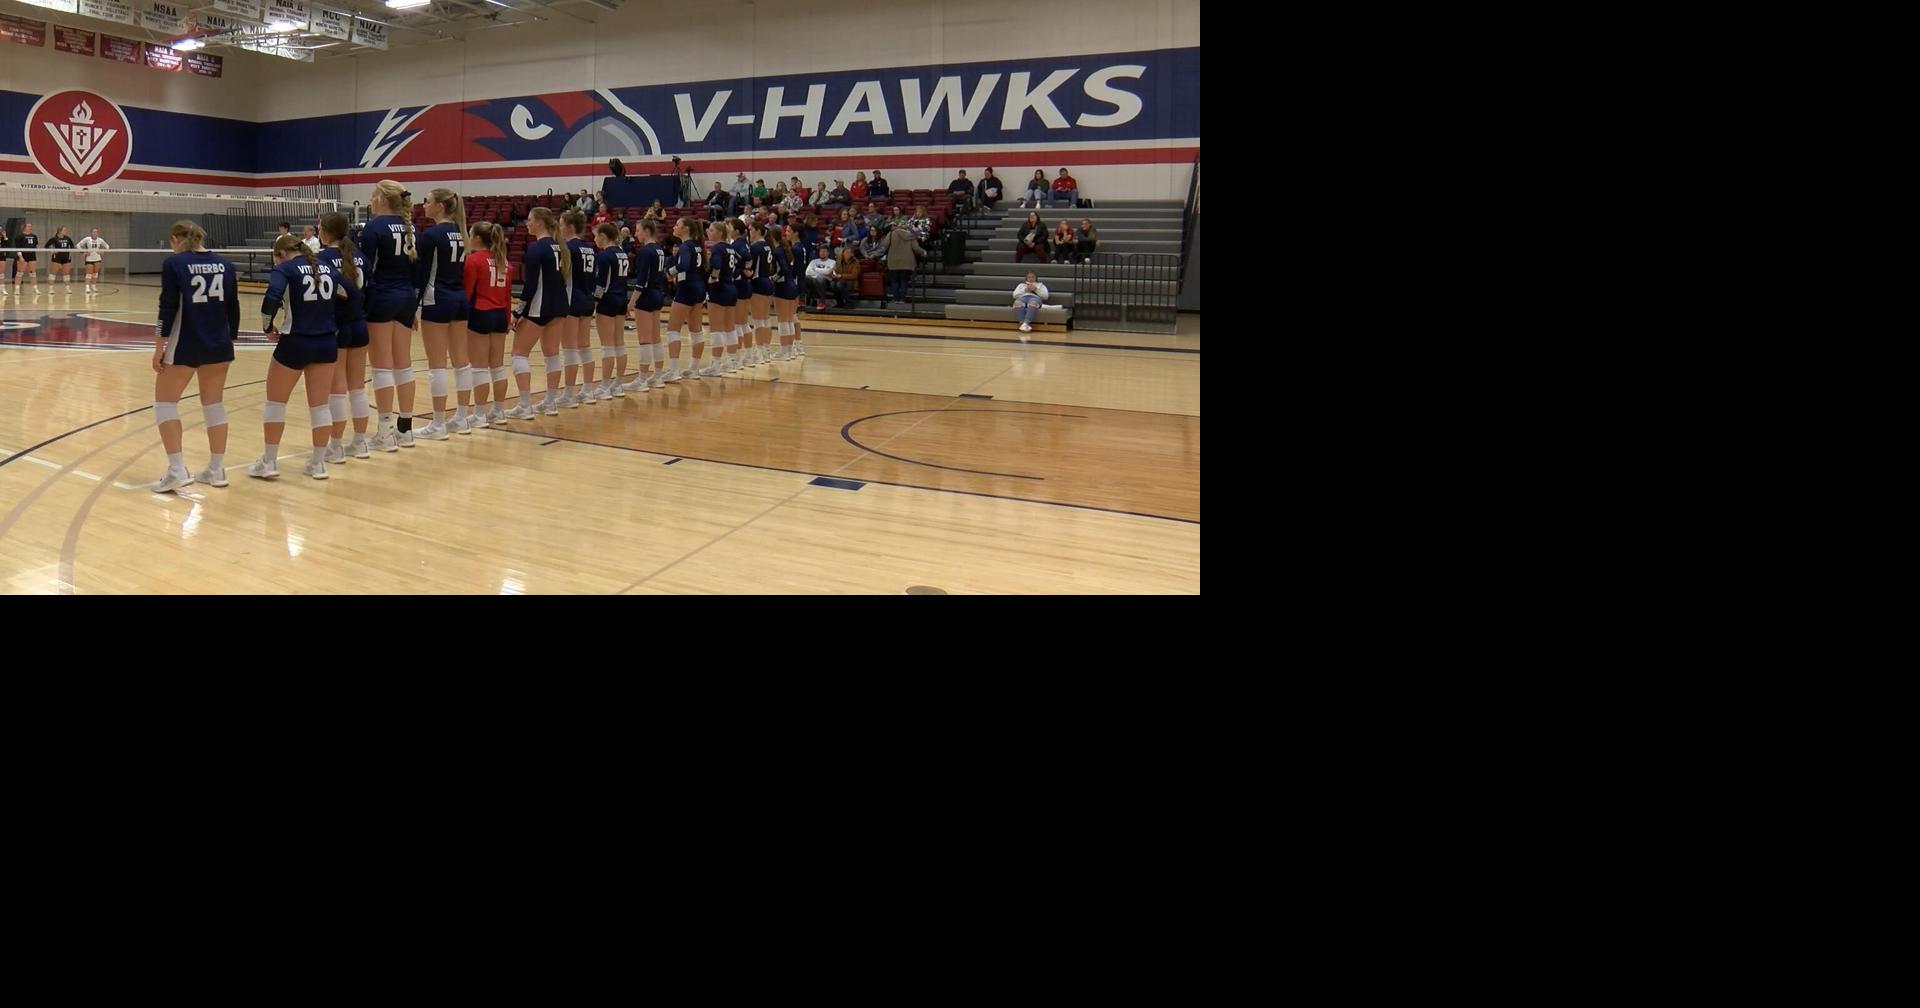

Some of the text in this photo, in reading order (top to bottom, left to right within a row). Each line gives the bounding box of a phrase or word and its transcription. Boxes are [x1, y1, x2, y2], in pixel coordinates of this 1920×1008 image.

[154, 2, 177, 17] NSAA
[207, 16, 226, 28] NAIA
[673, 65, 1147, 143] V-HAWKS
[449, 240, 465, 262] 17
[188, 263, 225, 275] VITERBO
[297, 264, 331, 275] VITBO
[581, 253, 595, 272] 13
[618, 259, 629, 276] 12
[728, 254, 735, 269] 8
[190, 273, 224, 303] 24
[302, 274, 334, 301] 20
